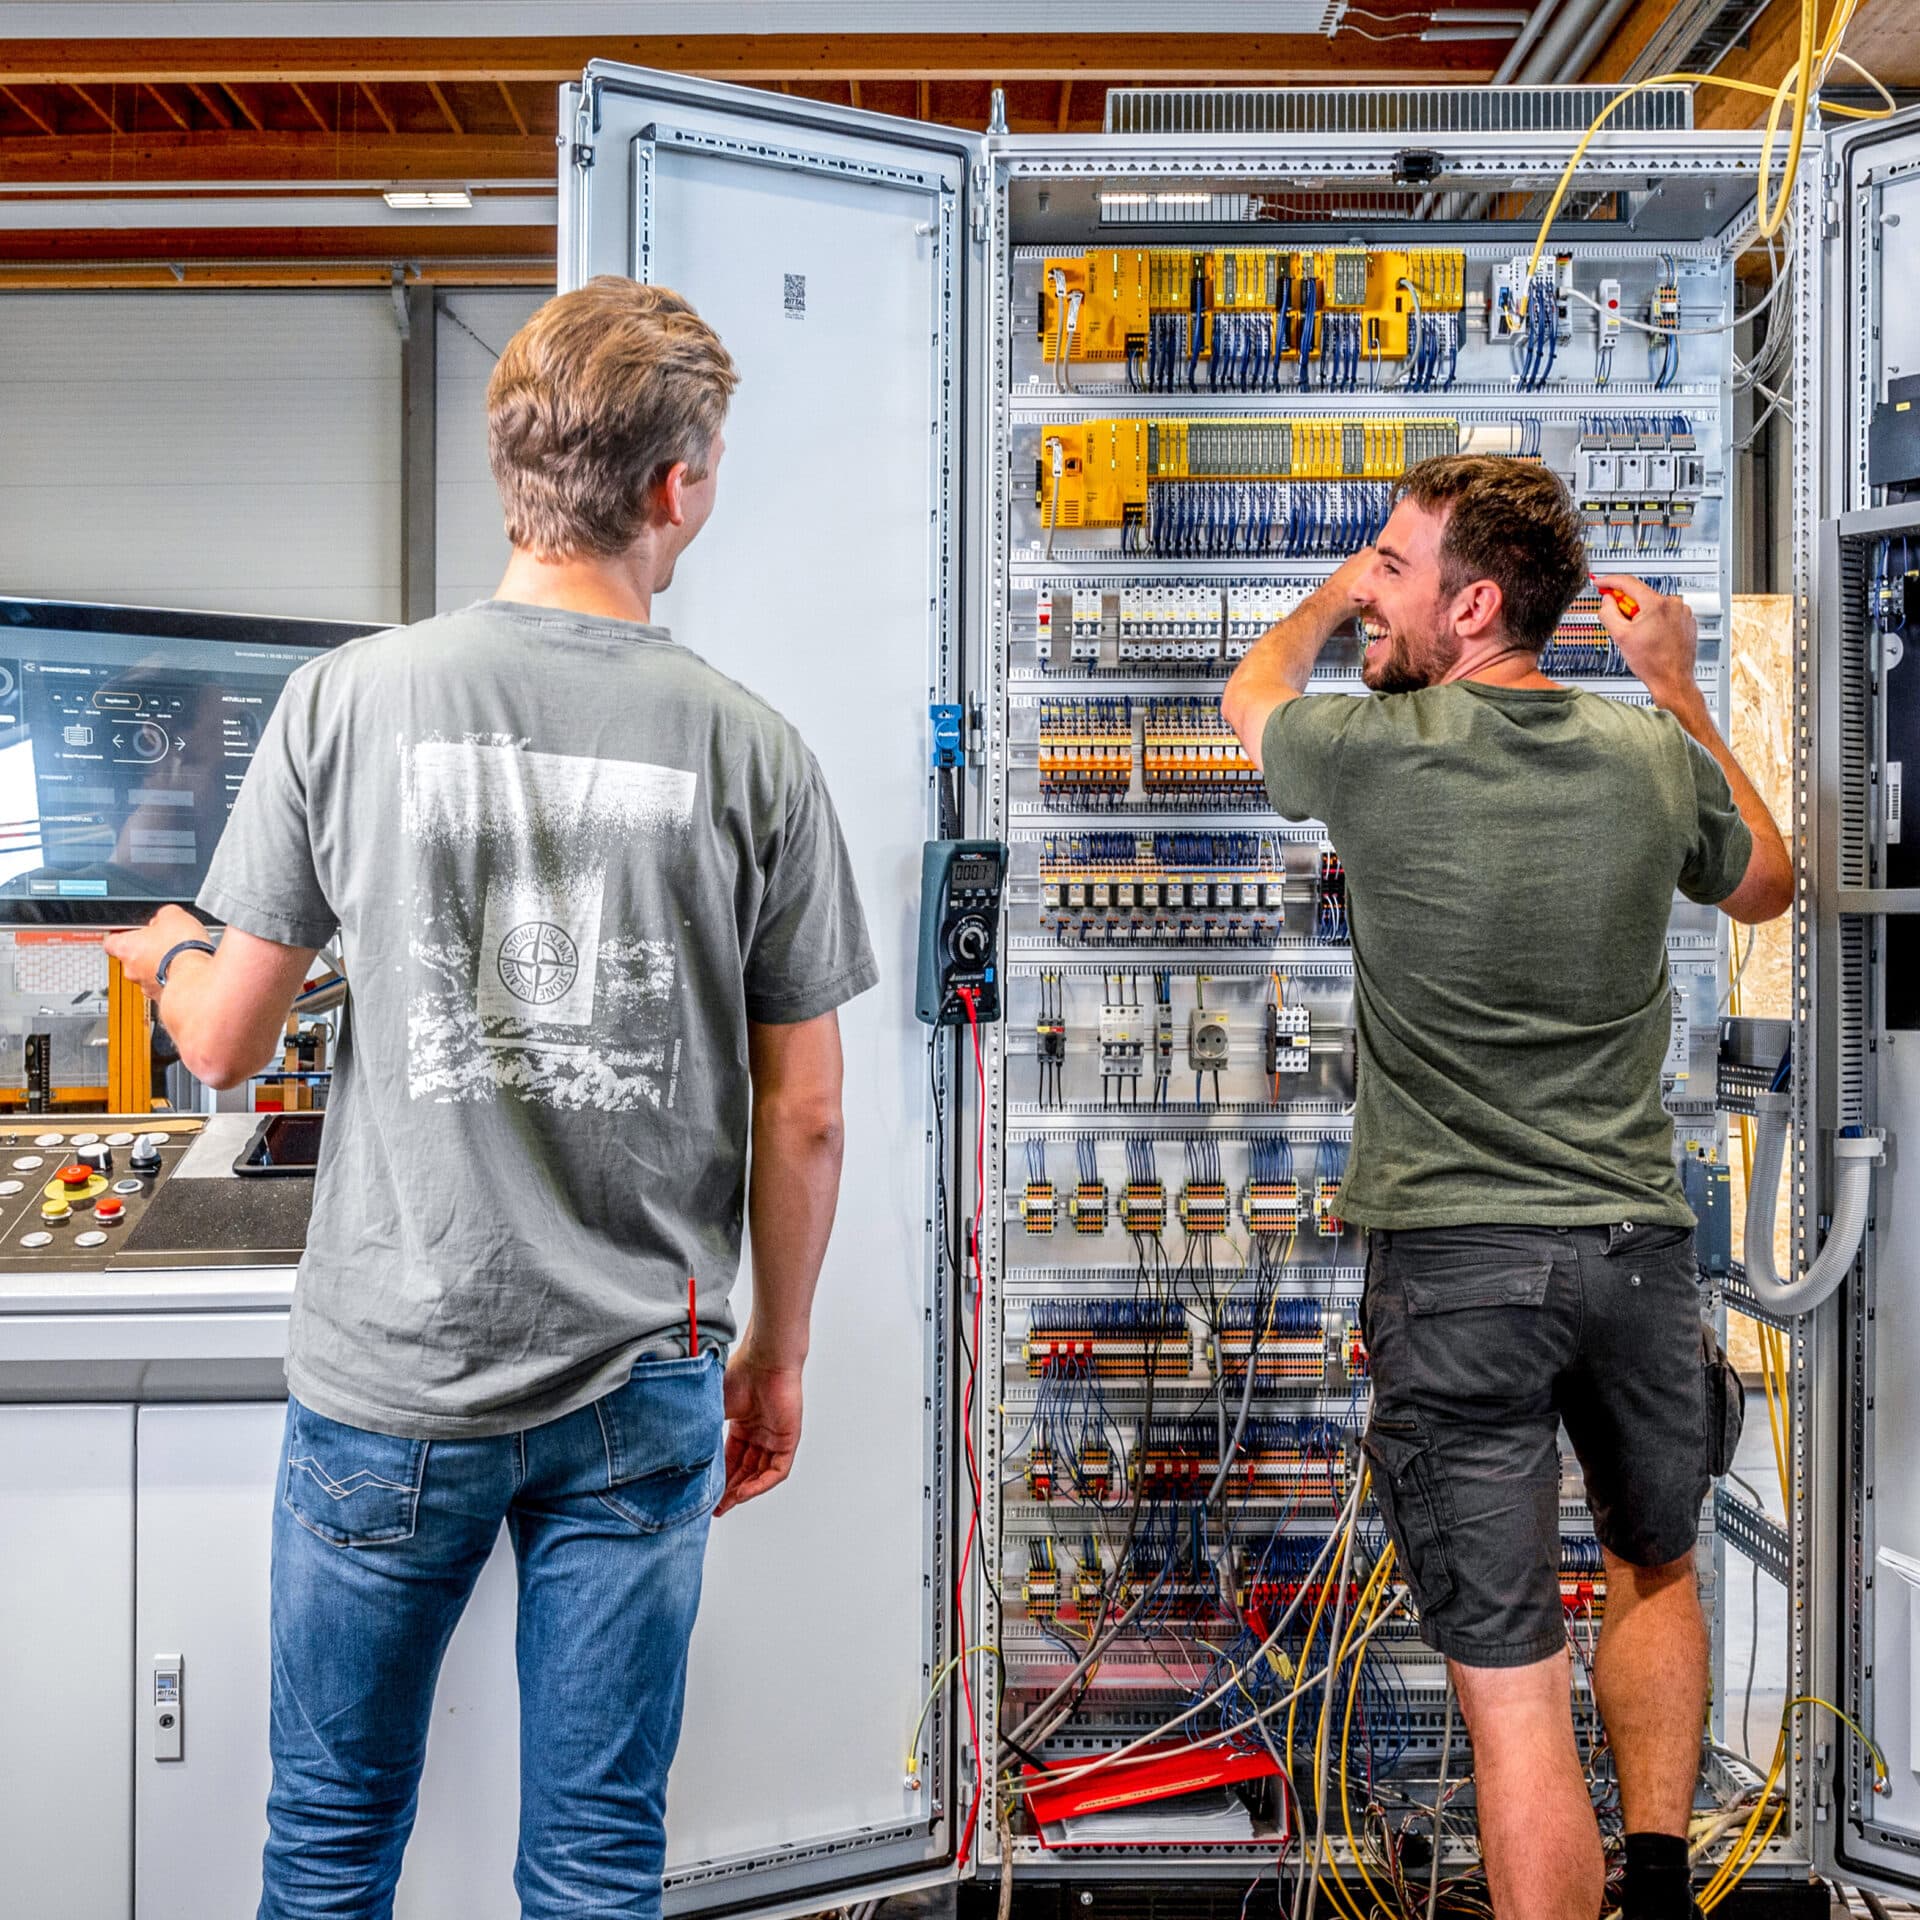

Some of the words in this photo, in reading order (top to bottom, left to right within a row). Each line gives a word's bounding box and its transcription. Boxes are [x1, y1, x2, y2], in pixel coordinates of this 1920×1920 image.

[504, 927, 535, 956] STONE
[544, 928, 574, 963] ISLAND
[502, 963, 532, 998] ISLAND
[540, 968, 572, 1000] STONE
